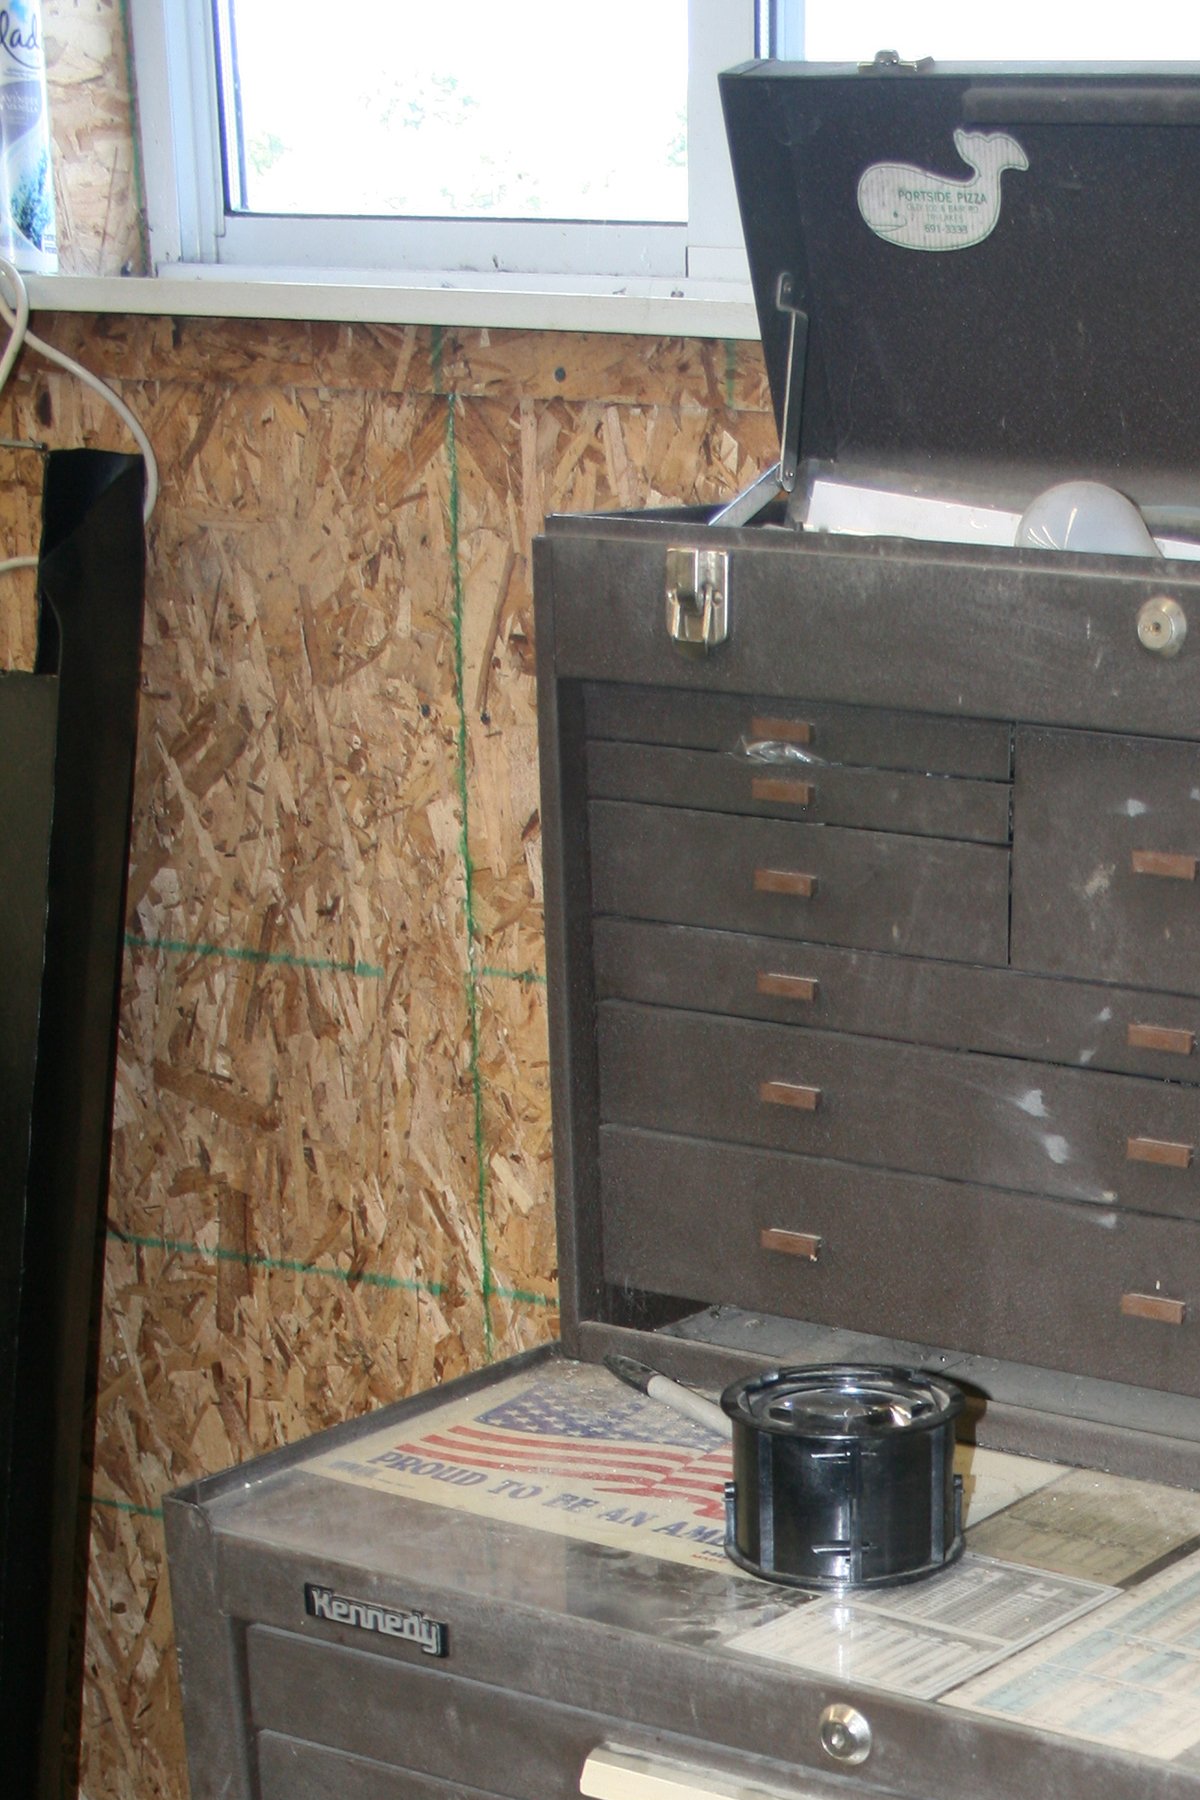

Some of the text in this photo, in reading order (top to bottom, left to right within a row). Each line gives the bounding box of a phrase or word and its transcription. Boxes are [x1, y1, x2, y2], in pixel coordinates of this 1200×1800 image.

[0, 10, 39, 50] lad
[898, 190, 987, 205] PORTSIDE PIZZA
[366, 1450, 490, 1487] PROUD
[487, 1479, 543, 1500] TO
[541, 1492, 601, 1514] BE
[598, 1506, 658, 1528] AN
[311, 1590, 441, 1656] Kennedy
